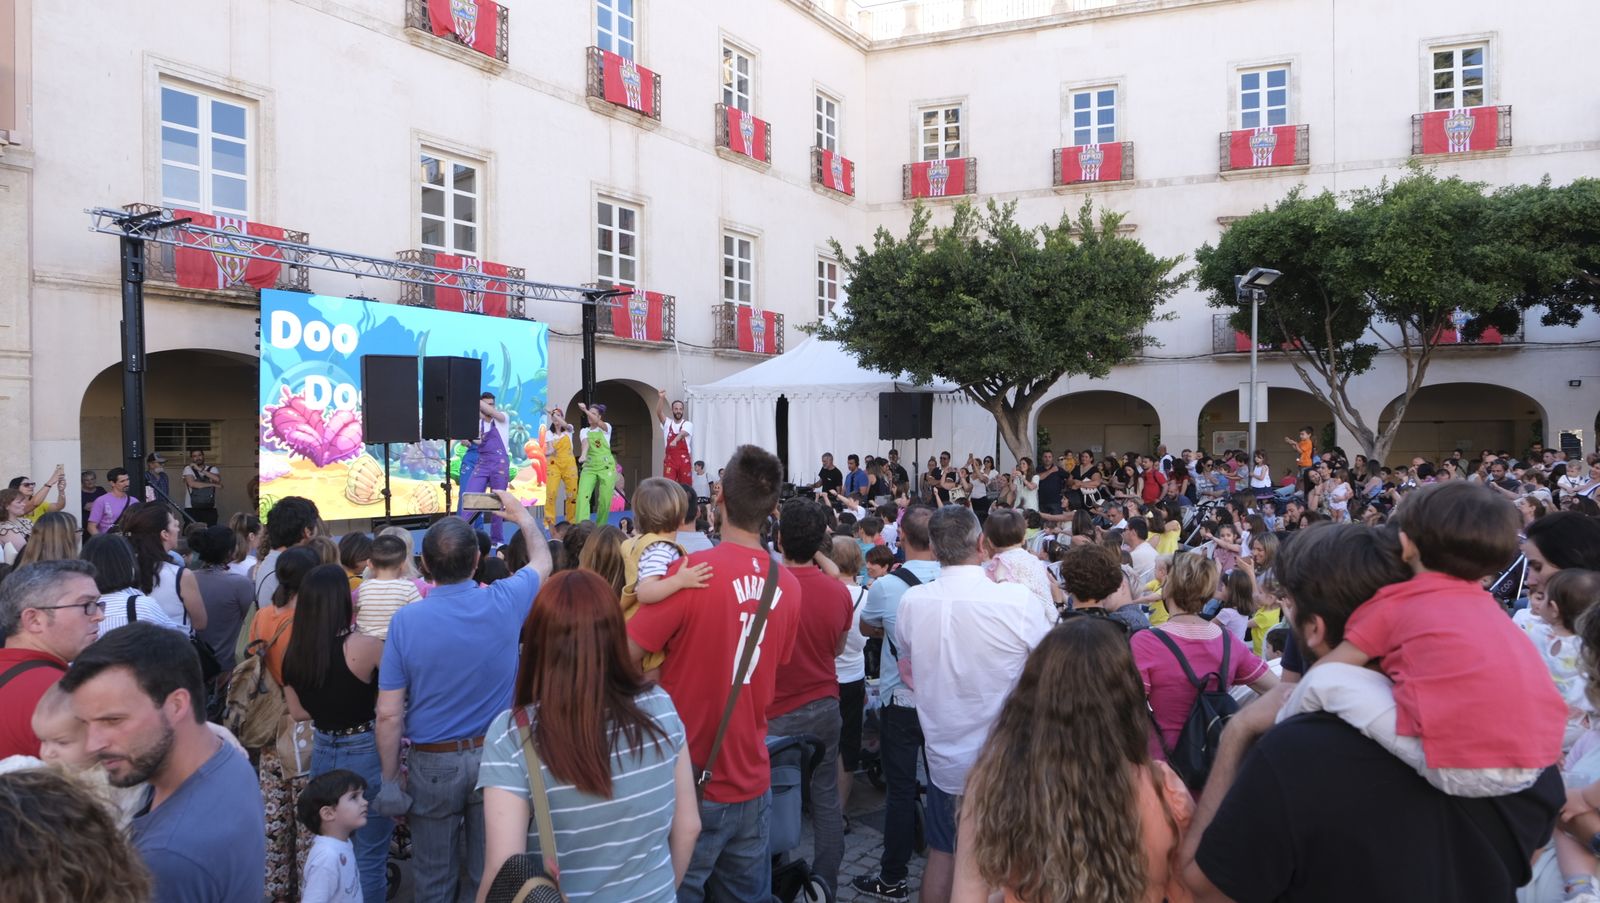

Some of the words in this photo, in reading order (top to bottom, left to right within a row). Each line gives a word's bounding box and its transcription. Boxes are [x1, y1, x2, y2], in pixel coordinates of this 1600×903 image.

[271, 310, 358, 353] Doo
[304, 374, 362, 411] Do
[732, 575, 783, 610] HARDN
